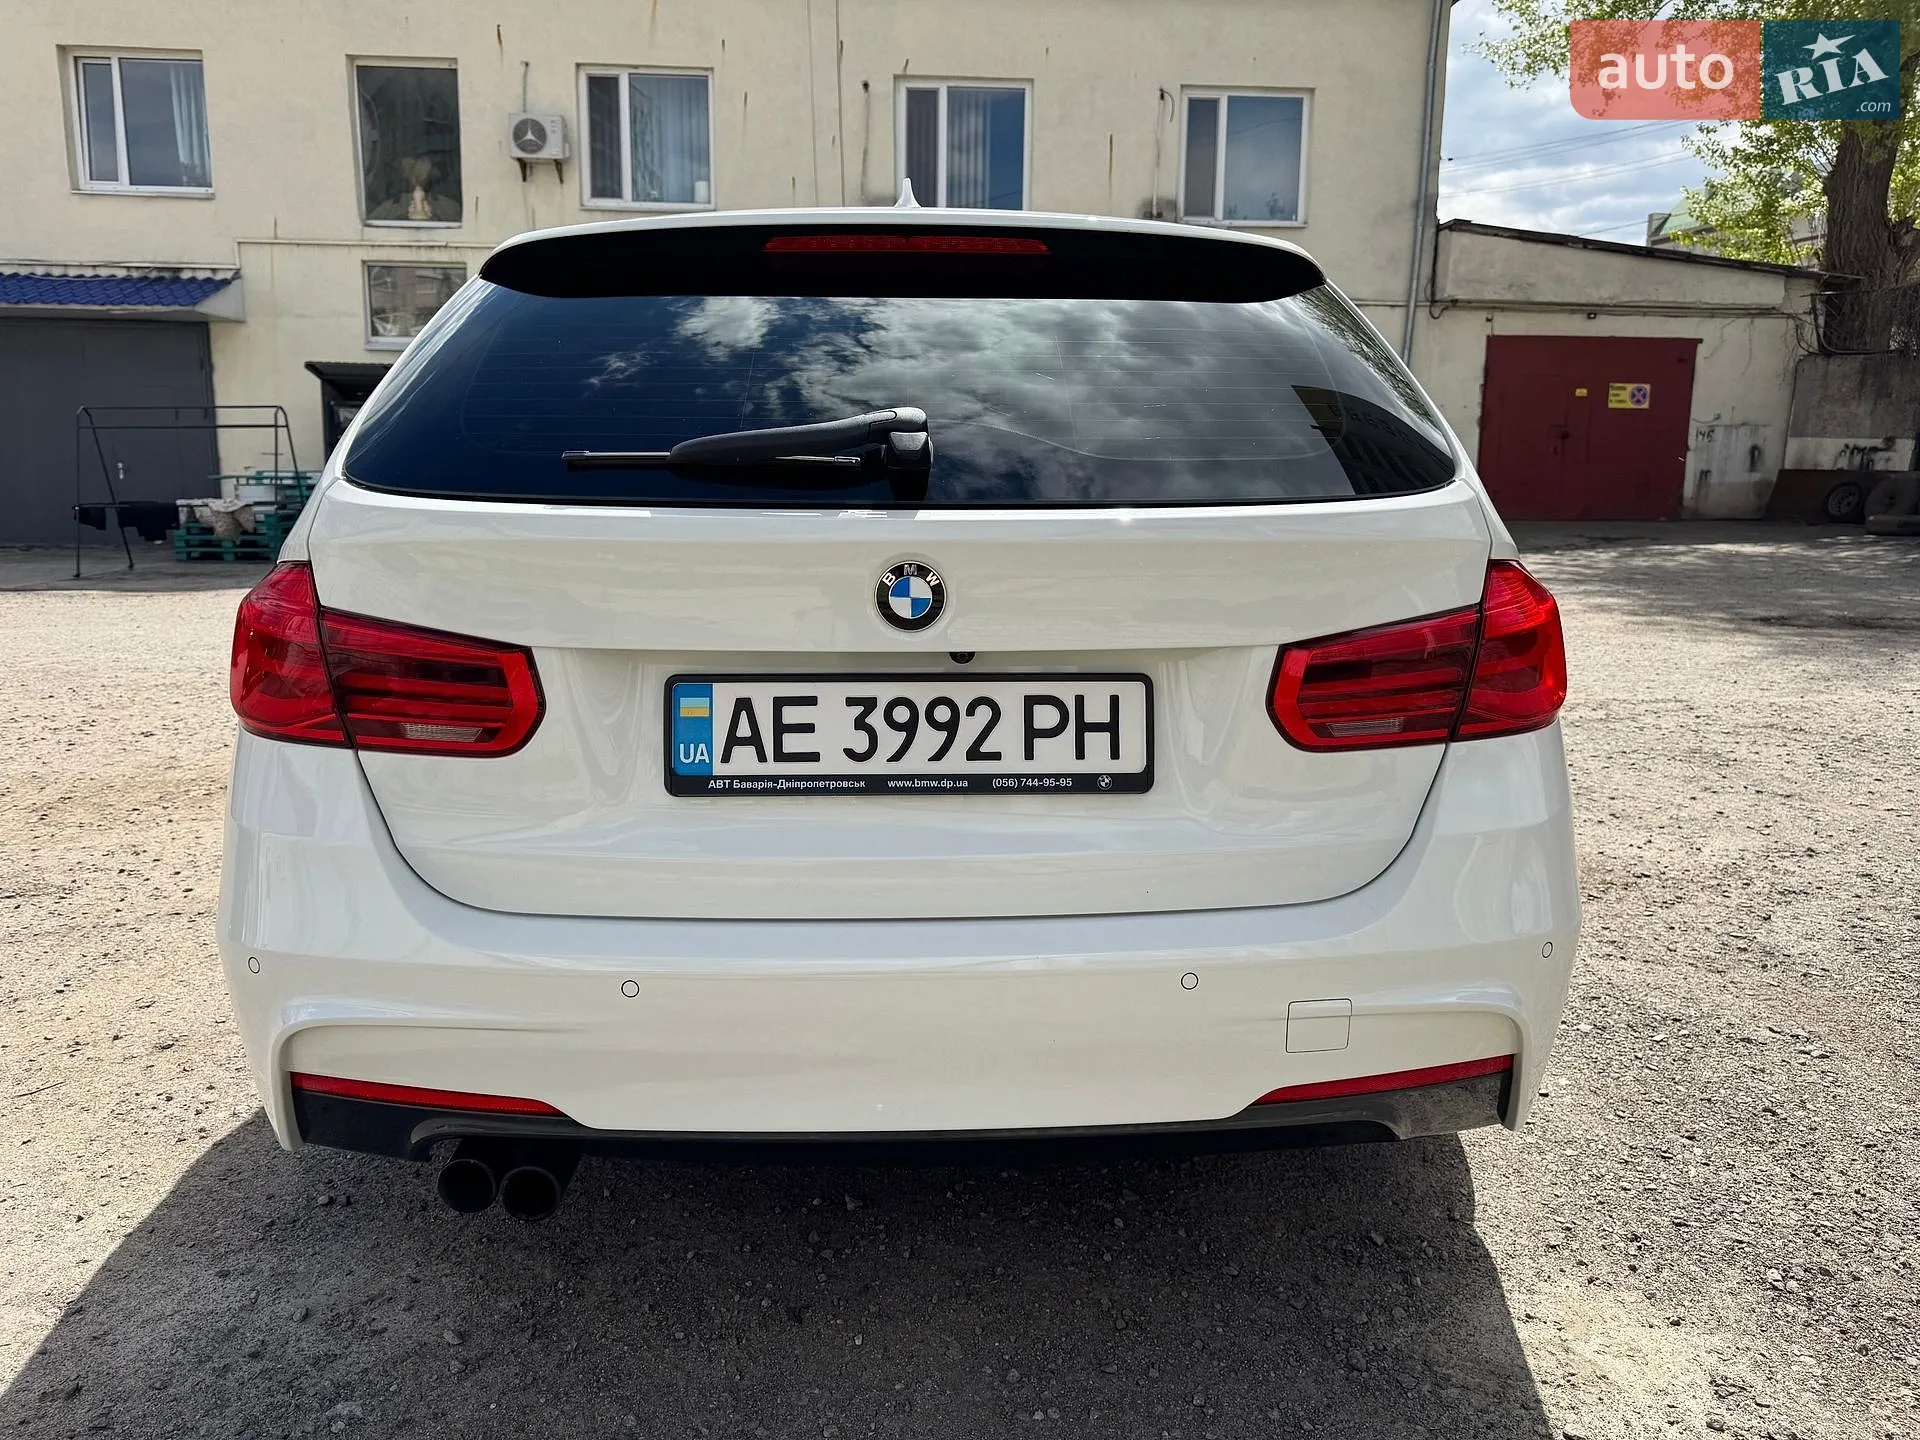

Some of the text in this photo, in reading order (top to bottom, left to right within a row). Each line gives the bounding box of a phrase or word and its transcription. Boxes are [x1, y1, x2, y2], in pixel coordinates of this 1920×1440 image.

[882, 564, 940, 587] BMW
[720, 694, 1121, 764] AE 3992 PH
[679, 743, 710, 764] UA
[733, 778, 866, 791] Баварія-Дніпропетровськ
[887, 778, 969, 790] www.bmw.dp.ua
[992, 777, 1073, 789] (056) 744-95-95
